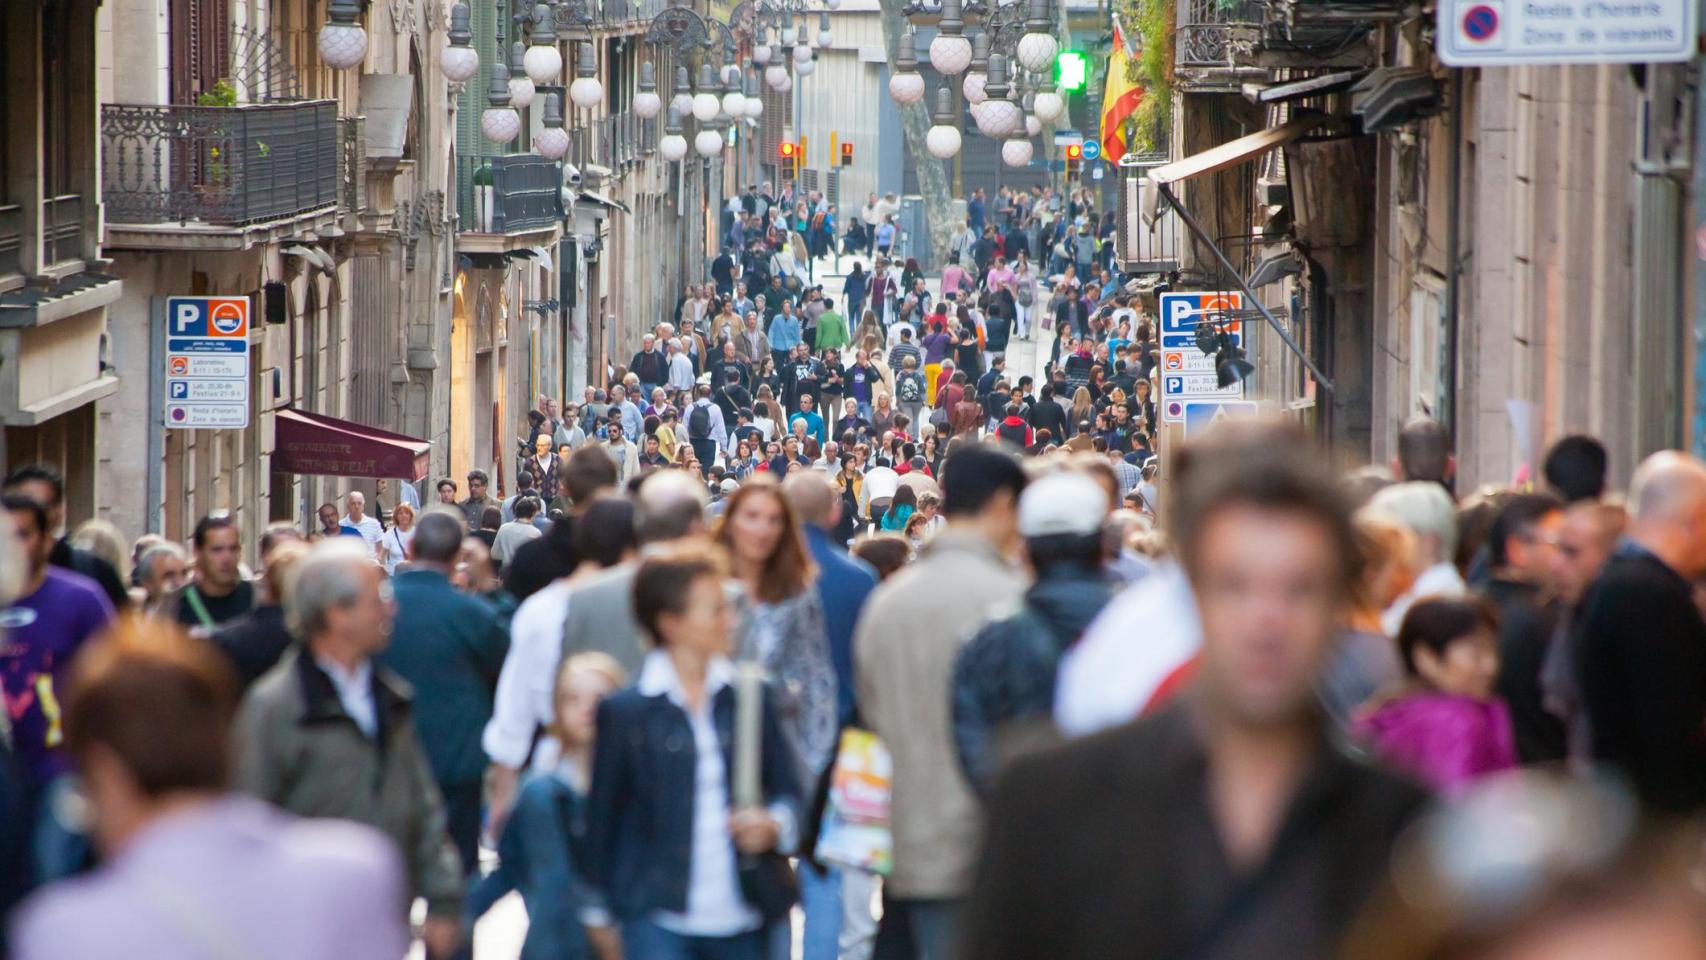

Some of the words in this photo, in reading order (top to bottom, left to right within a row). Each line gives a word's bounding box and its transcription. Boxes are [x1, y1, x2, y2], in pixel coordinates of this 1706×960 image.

[177, 304, 200, 332] P
[1171, 300, 1193, 328] P
[173, 383, 186, 398] P
[1169, 379, 1181, 393] P
